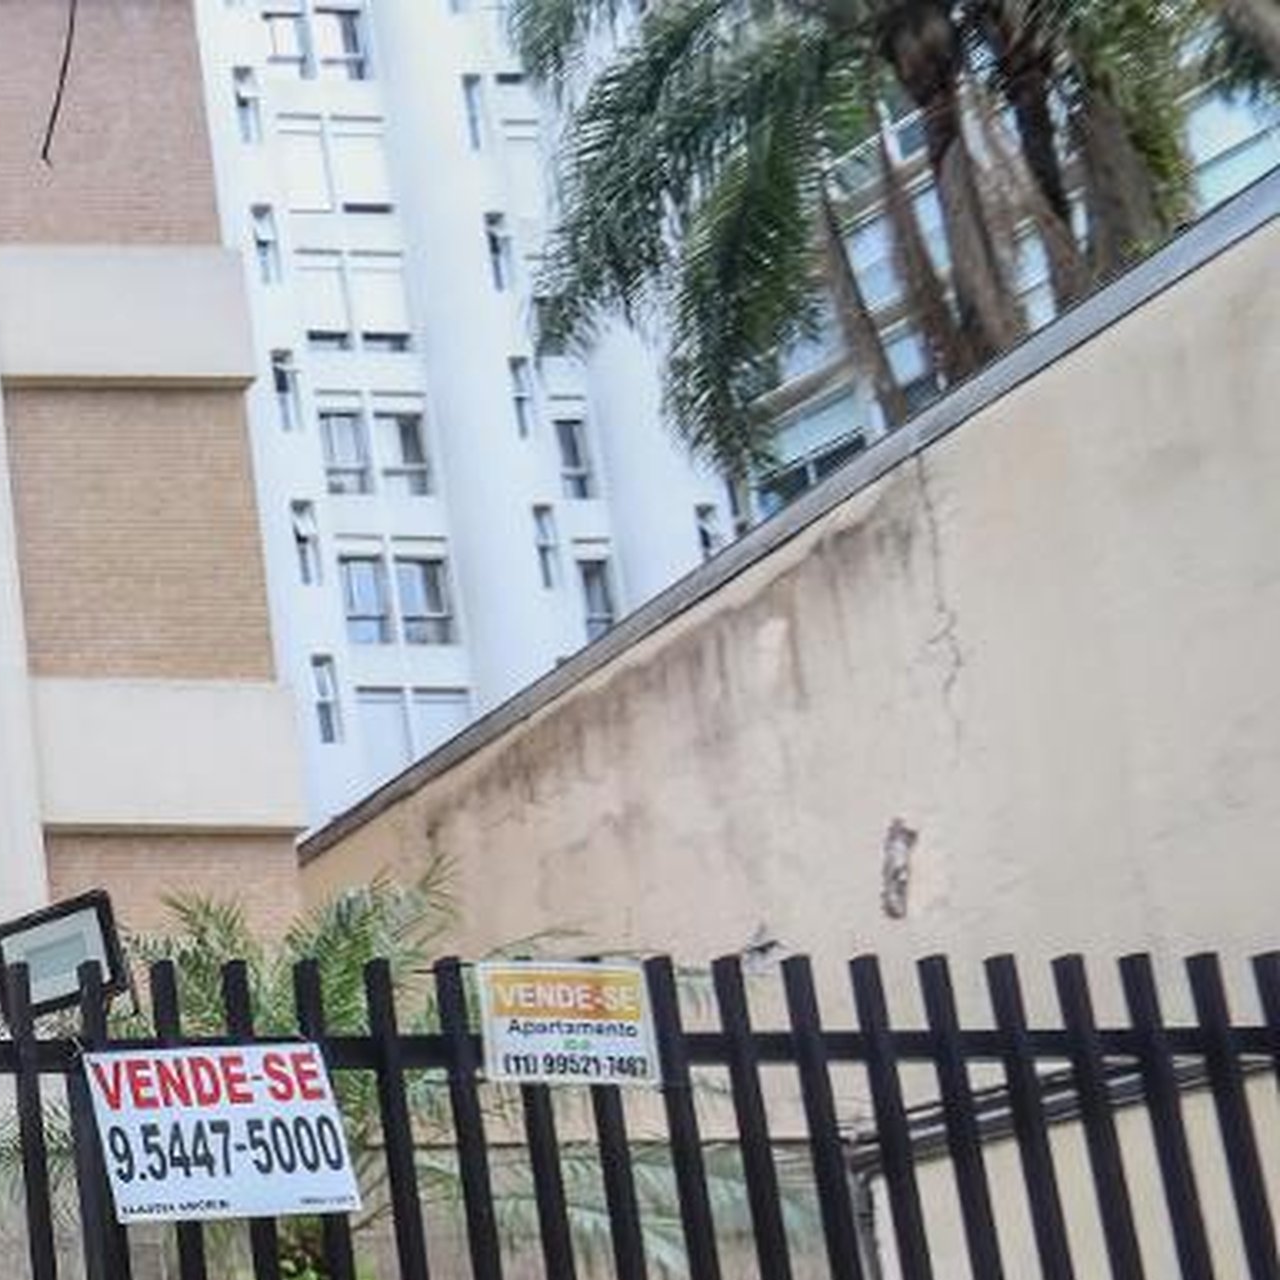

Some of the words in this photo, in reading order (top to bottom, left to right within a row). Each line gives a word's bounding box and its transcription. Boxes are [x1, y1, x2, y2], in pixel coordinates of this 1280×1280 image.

[496, 981, 636, 1012] VENDE-SE
[507, 1018, 639, 1038] Apartamento
[504, 1053, 538, 1075] (11)
[92, 1052, 325, 1111] VENDE-SE
[108, 1114, 345, 1183] 9.5447-5000
